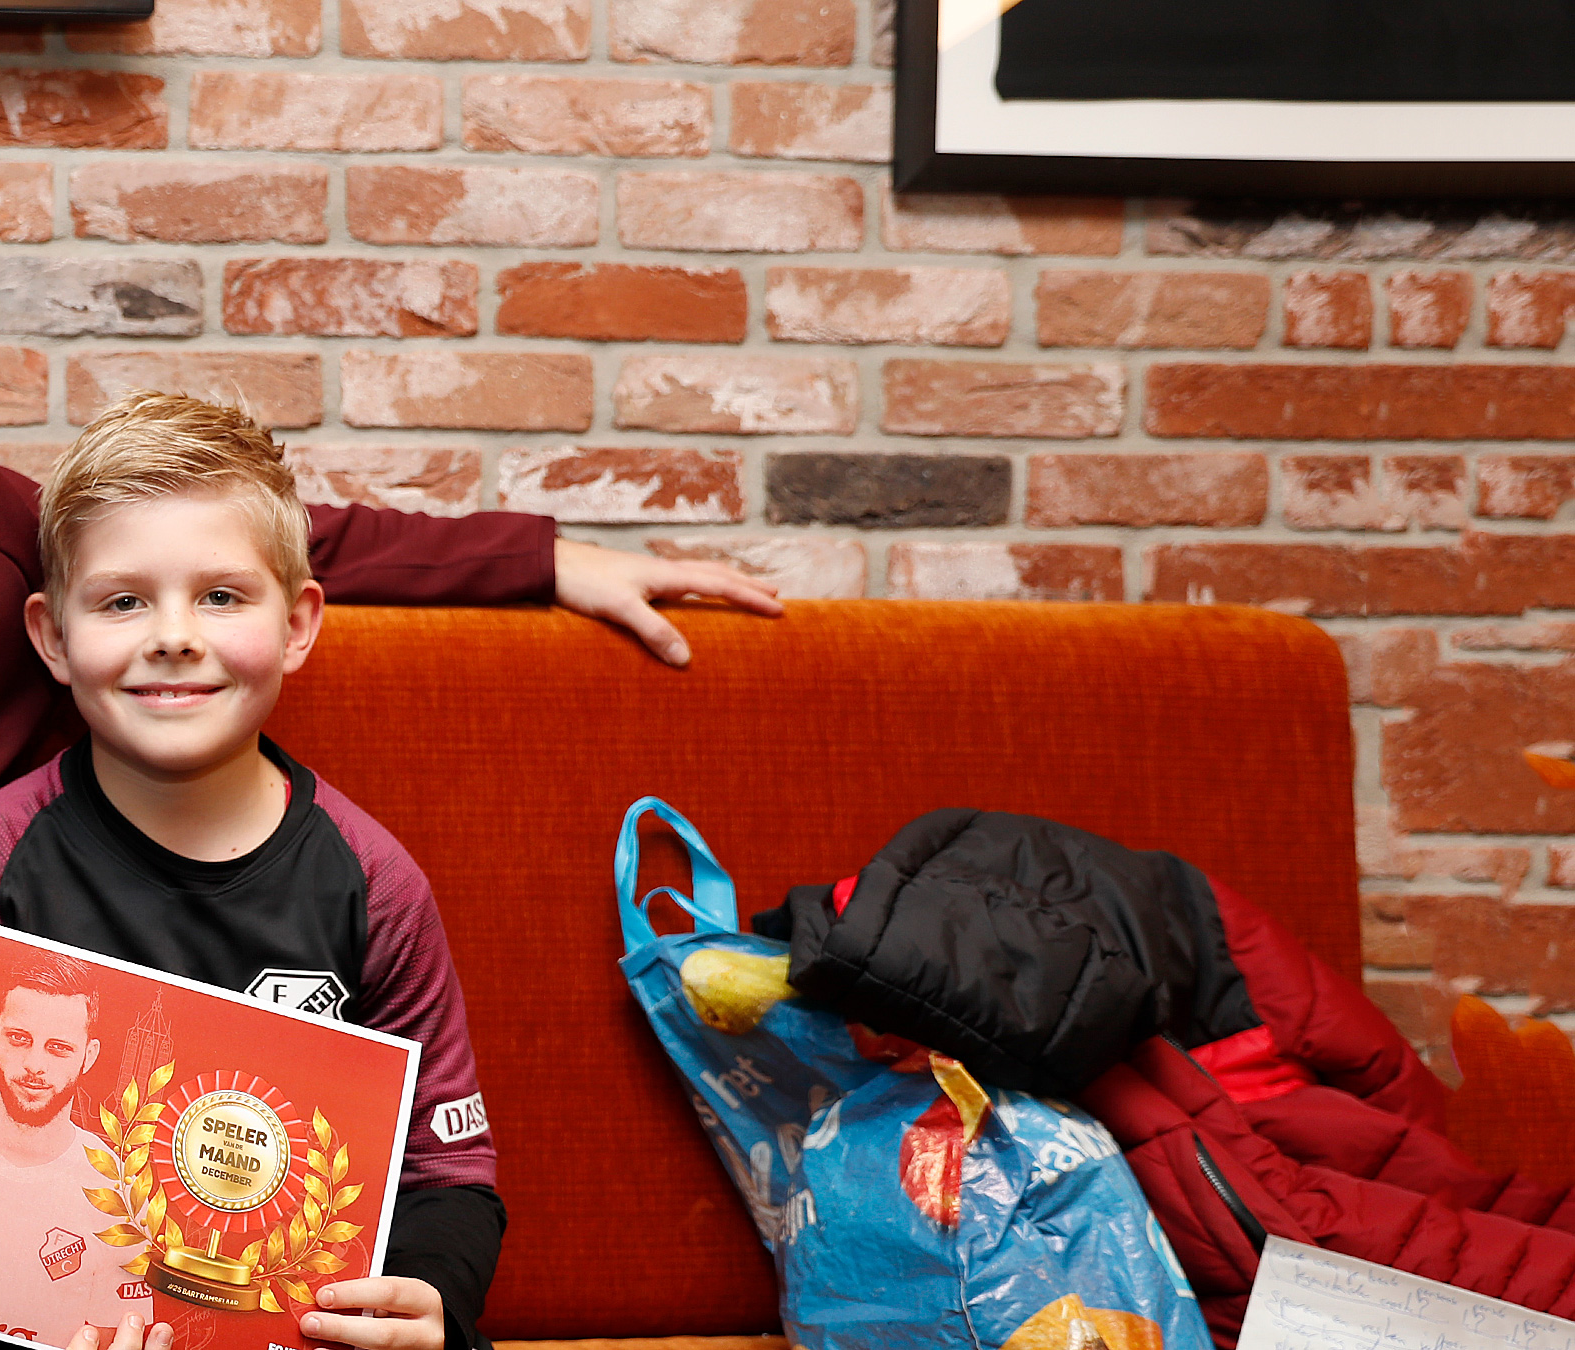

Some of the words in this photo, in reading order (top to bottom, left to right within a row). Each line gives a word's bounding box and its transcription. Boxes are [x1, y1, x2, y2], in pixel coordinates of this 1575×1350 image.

[202, 1116, 268, 1147] SPELER
[223, 1139, 234, 1149] VAN
[234, 1143, 244, 1151] DE
[199, 1143, 261, 1173] MAAND
[201, 1166, 252, 1188] DECEMBER
[42, 1240, 86, 1267] UTRECHT
